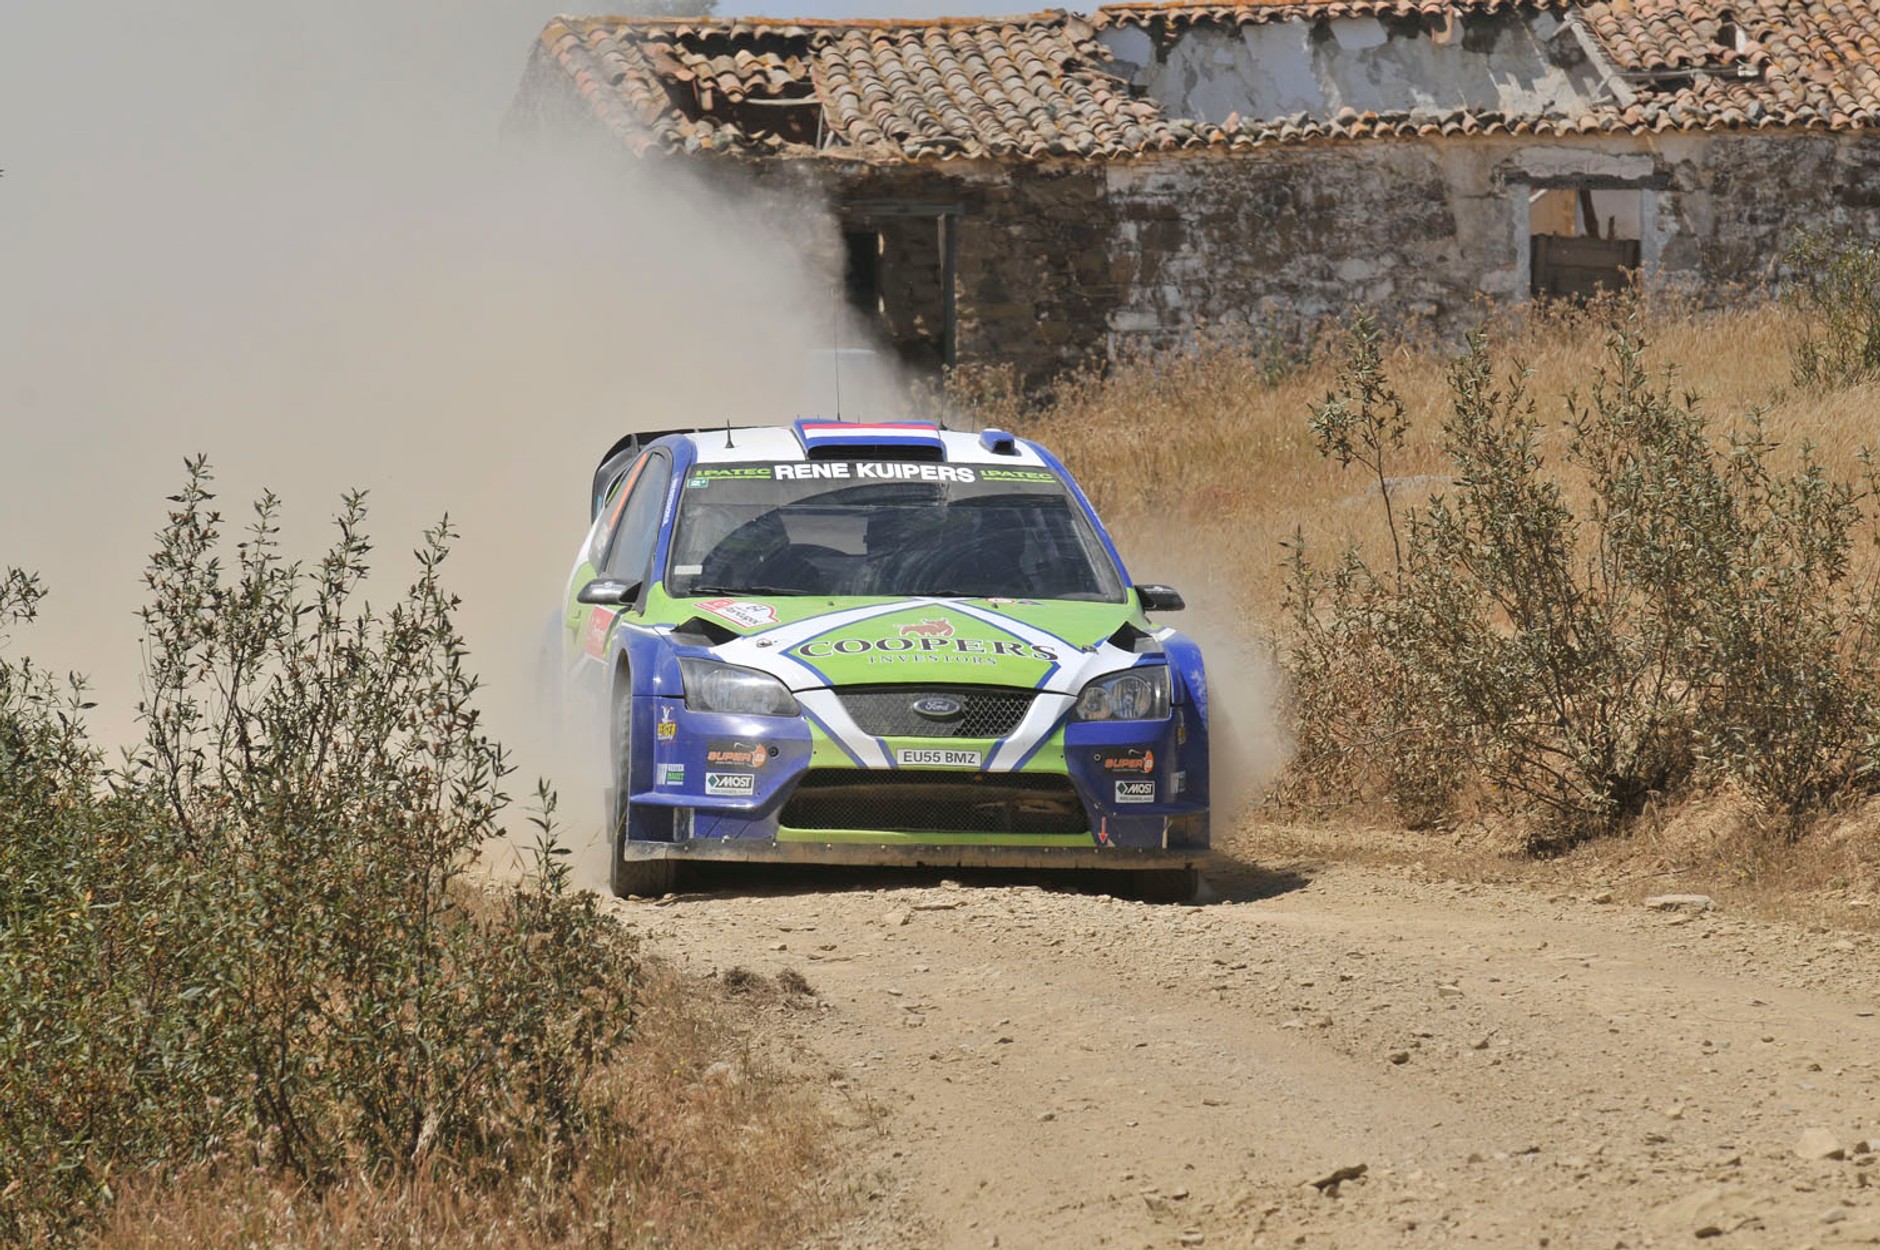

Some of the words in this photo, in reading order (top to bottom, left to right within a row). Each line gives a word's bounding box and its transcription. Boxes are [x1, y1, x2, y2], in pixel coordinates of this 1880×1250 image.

[774, 463, 850, 480] RENE
[856, 462, 976, 483] KUIPERS
[798, 637, 1060, 661] COOPERS
[868, 654, 997, 665] INVESTORS
[925, 701, 949, 711] Ford
[707, 751, 752, 762] SUPER
[903, 751, 941, 763] EU55
[945, 752, 976, 764] BMZ
[1104, 758, 1143, 769] SUPER
[718, 776, 752, 788] MOST
[1126, 783, 1153, 794] MOST
